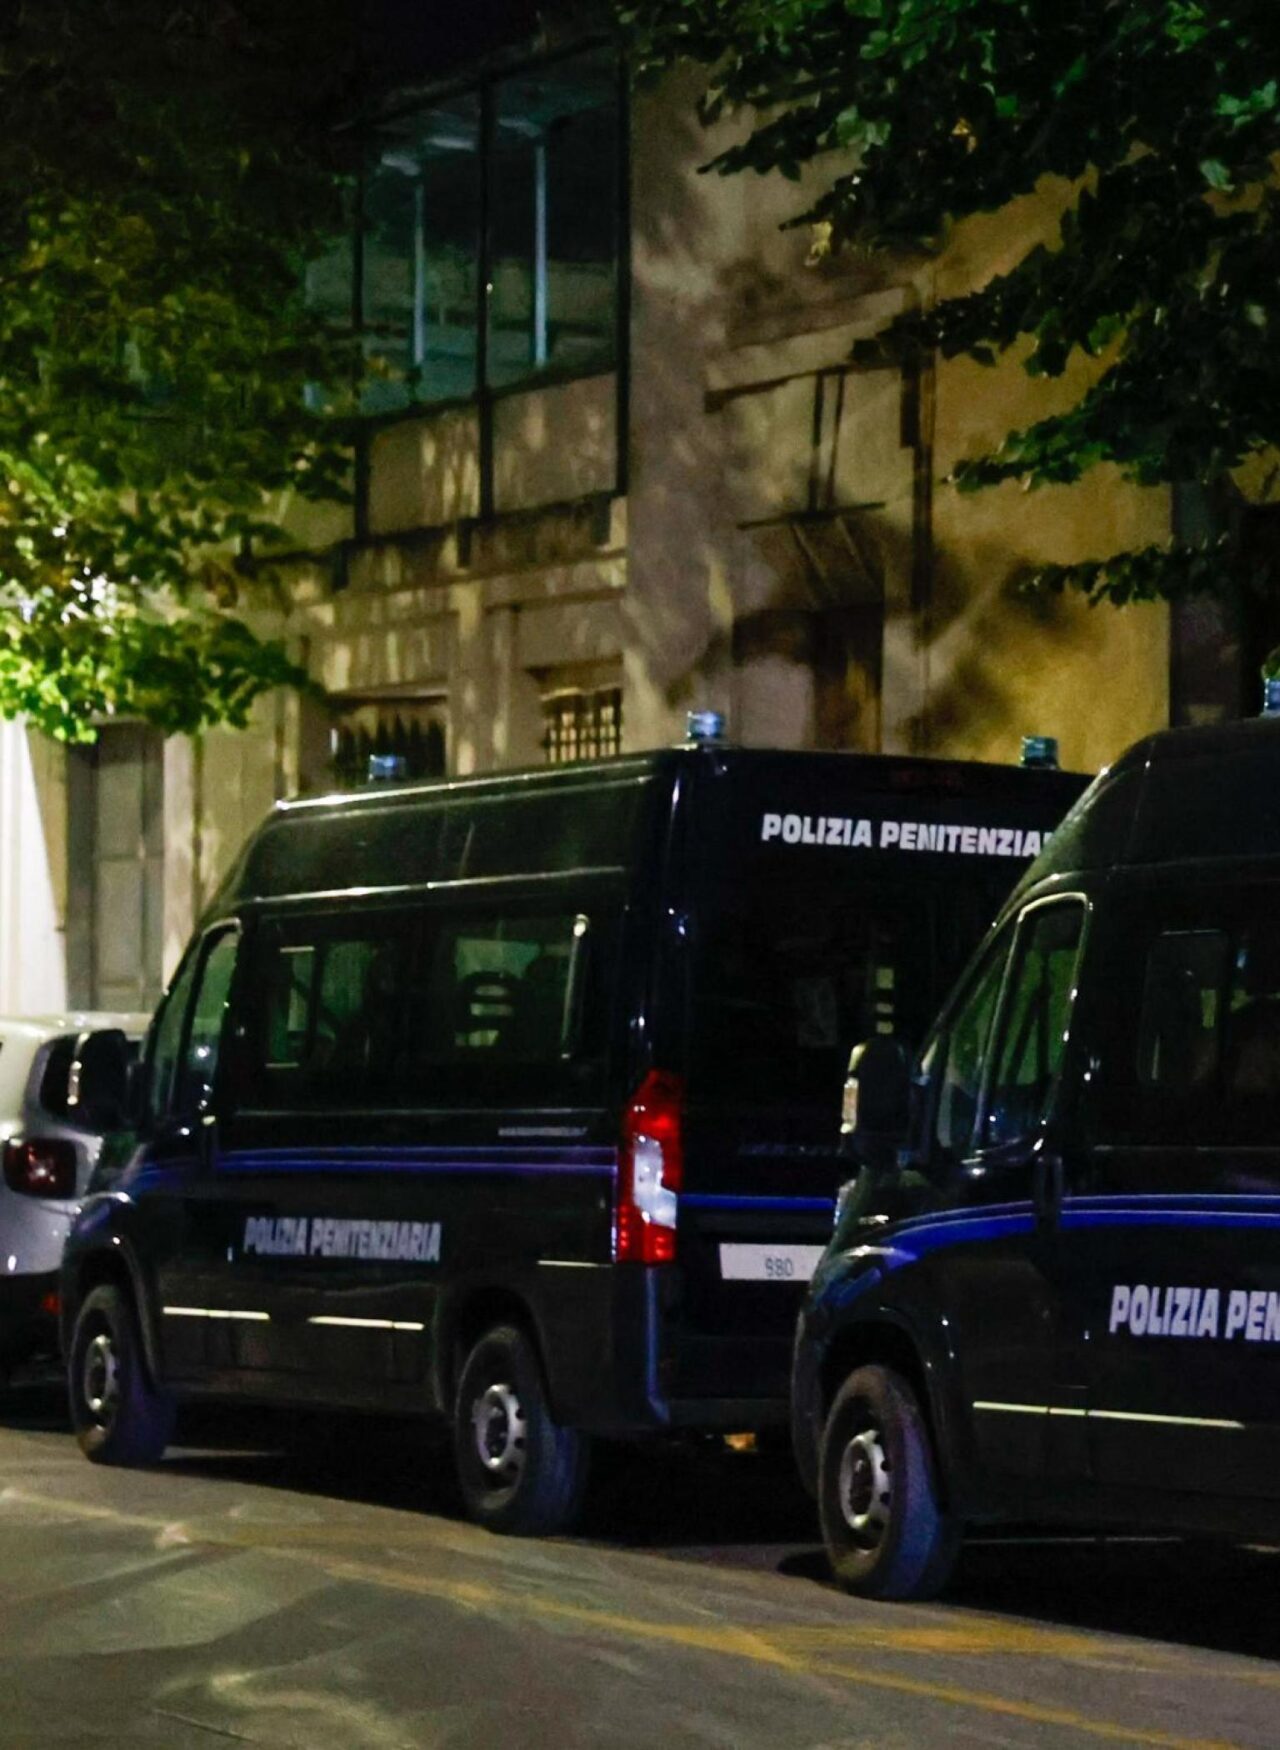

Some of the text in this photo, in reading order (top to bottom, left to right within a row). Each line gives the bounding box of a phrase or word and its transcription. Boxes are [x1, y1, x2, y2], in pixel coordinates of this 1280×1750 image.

[760, 812, 873, 848] POLIZIA
[243, 1216, 442, 1262] POLIZIA PENITENZIARIA
[1109, 1285, 1219, 1337] POLIZIA
